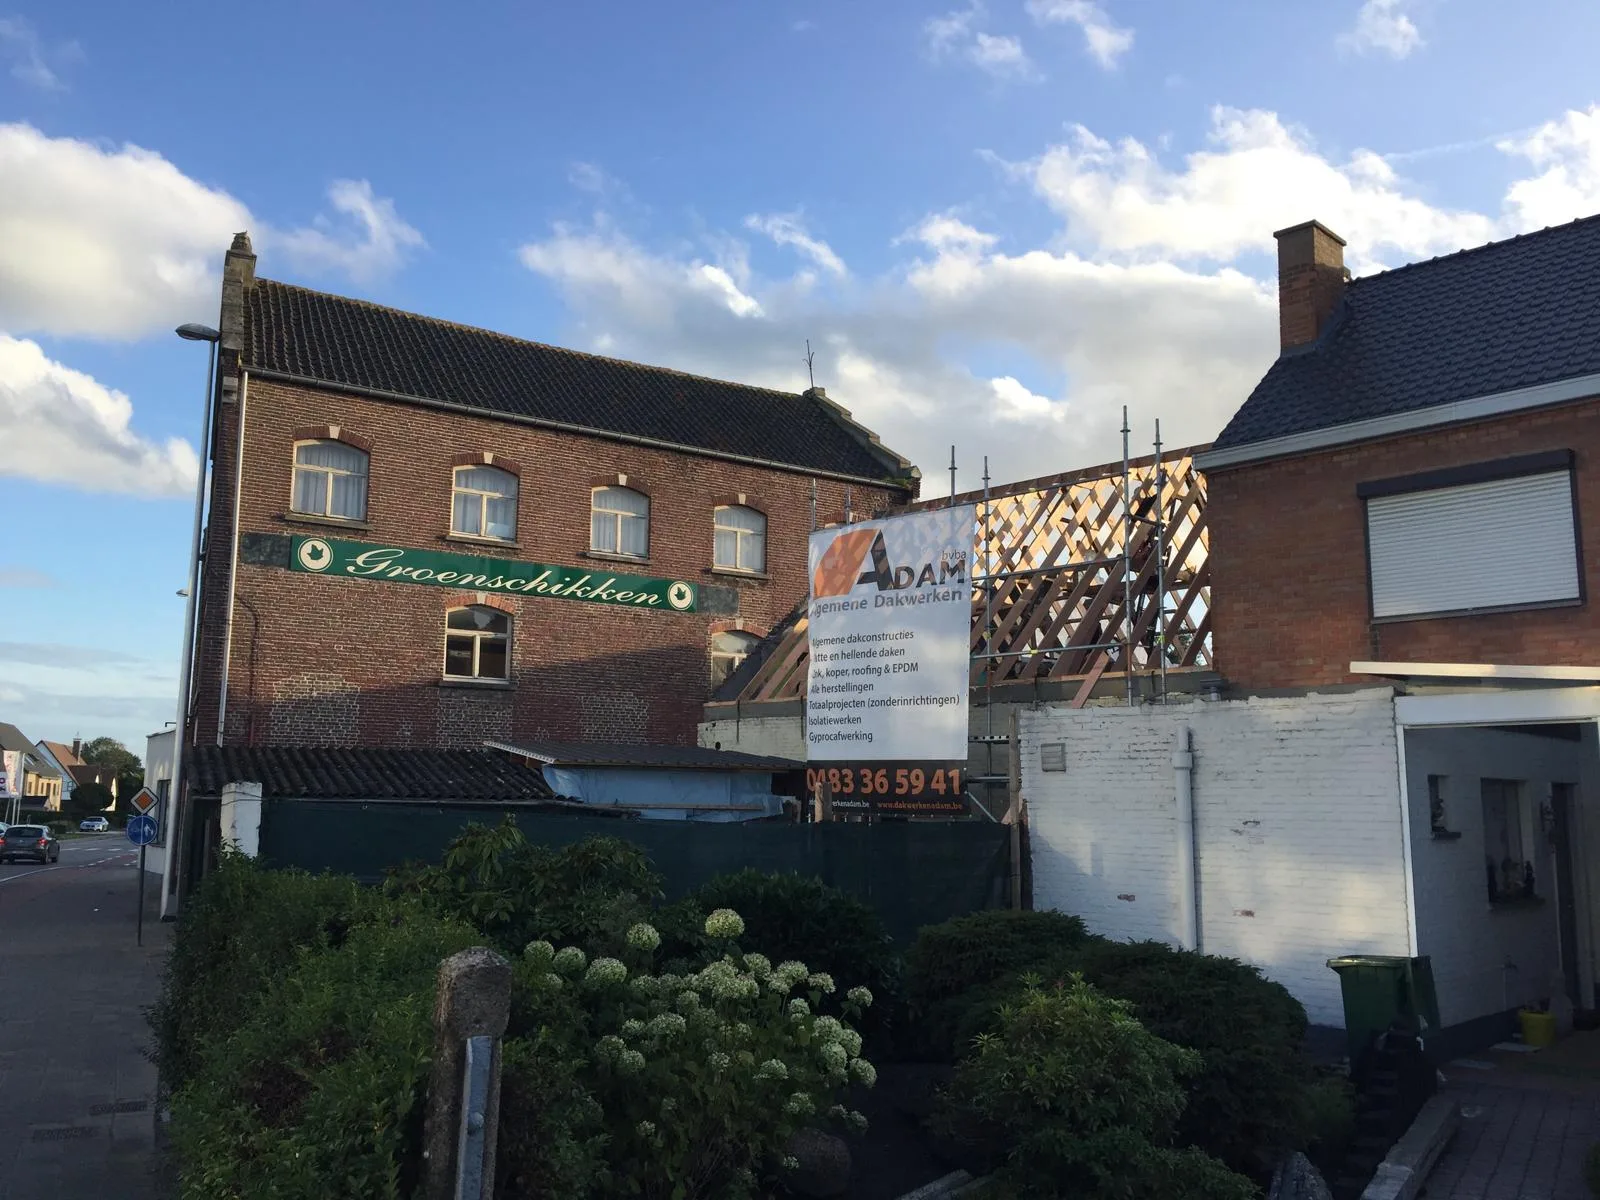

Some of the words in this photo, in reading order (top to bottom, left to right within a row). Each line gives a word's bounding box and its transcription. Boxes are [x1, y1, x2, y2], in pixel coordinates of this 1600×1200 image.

[856, 529, 966, 591] ADAM
[941, 550, 967, 561] bvba
[345, 548, 662, 605] Groenschikken
[874, 589, 962, 608] Dakwerken
[847, 630, 914, 644] dakconstructies
[829, 653, 840, 661] en
[841, 649, 878, 660] hellende
[879, 647, 905, 657] daken
[825, 668, 850, 679] koper,
[851, 664, 882, 677] roofing
[883, 665, 891, 674] &
[892, 662, 919, 673] EPDM
[821, 682, 874, 694] herstellingen
[809, 699, 866, 712] Totaalprojecten
[867, 694, 960, 708] (zonderinrichtingen)
[808, 715, 862, 725] Isolatiewerken
[809, 731, 873, 743] Gyprocafwerking
[860, 768, 889, 794] 36
[895, 769, 925, 795] 59
[931, 768, 961, 795] 41
